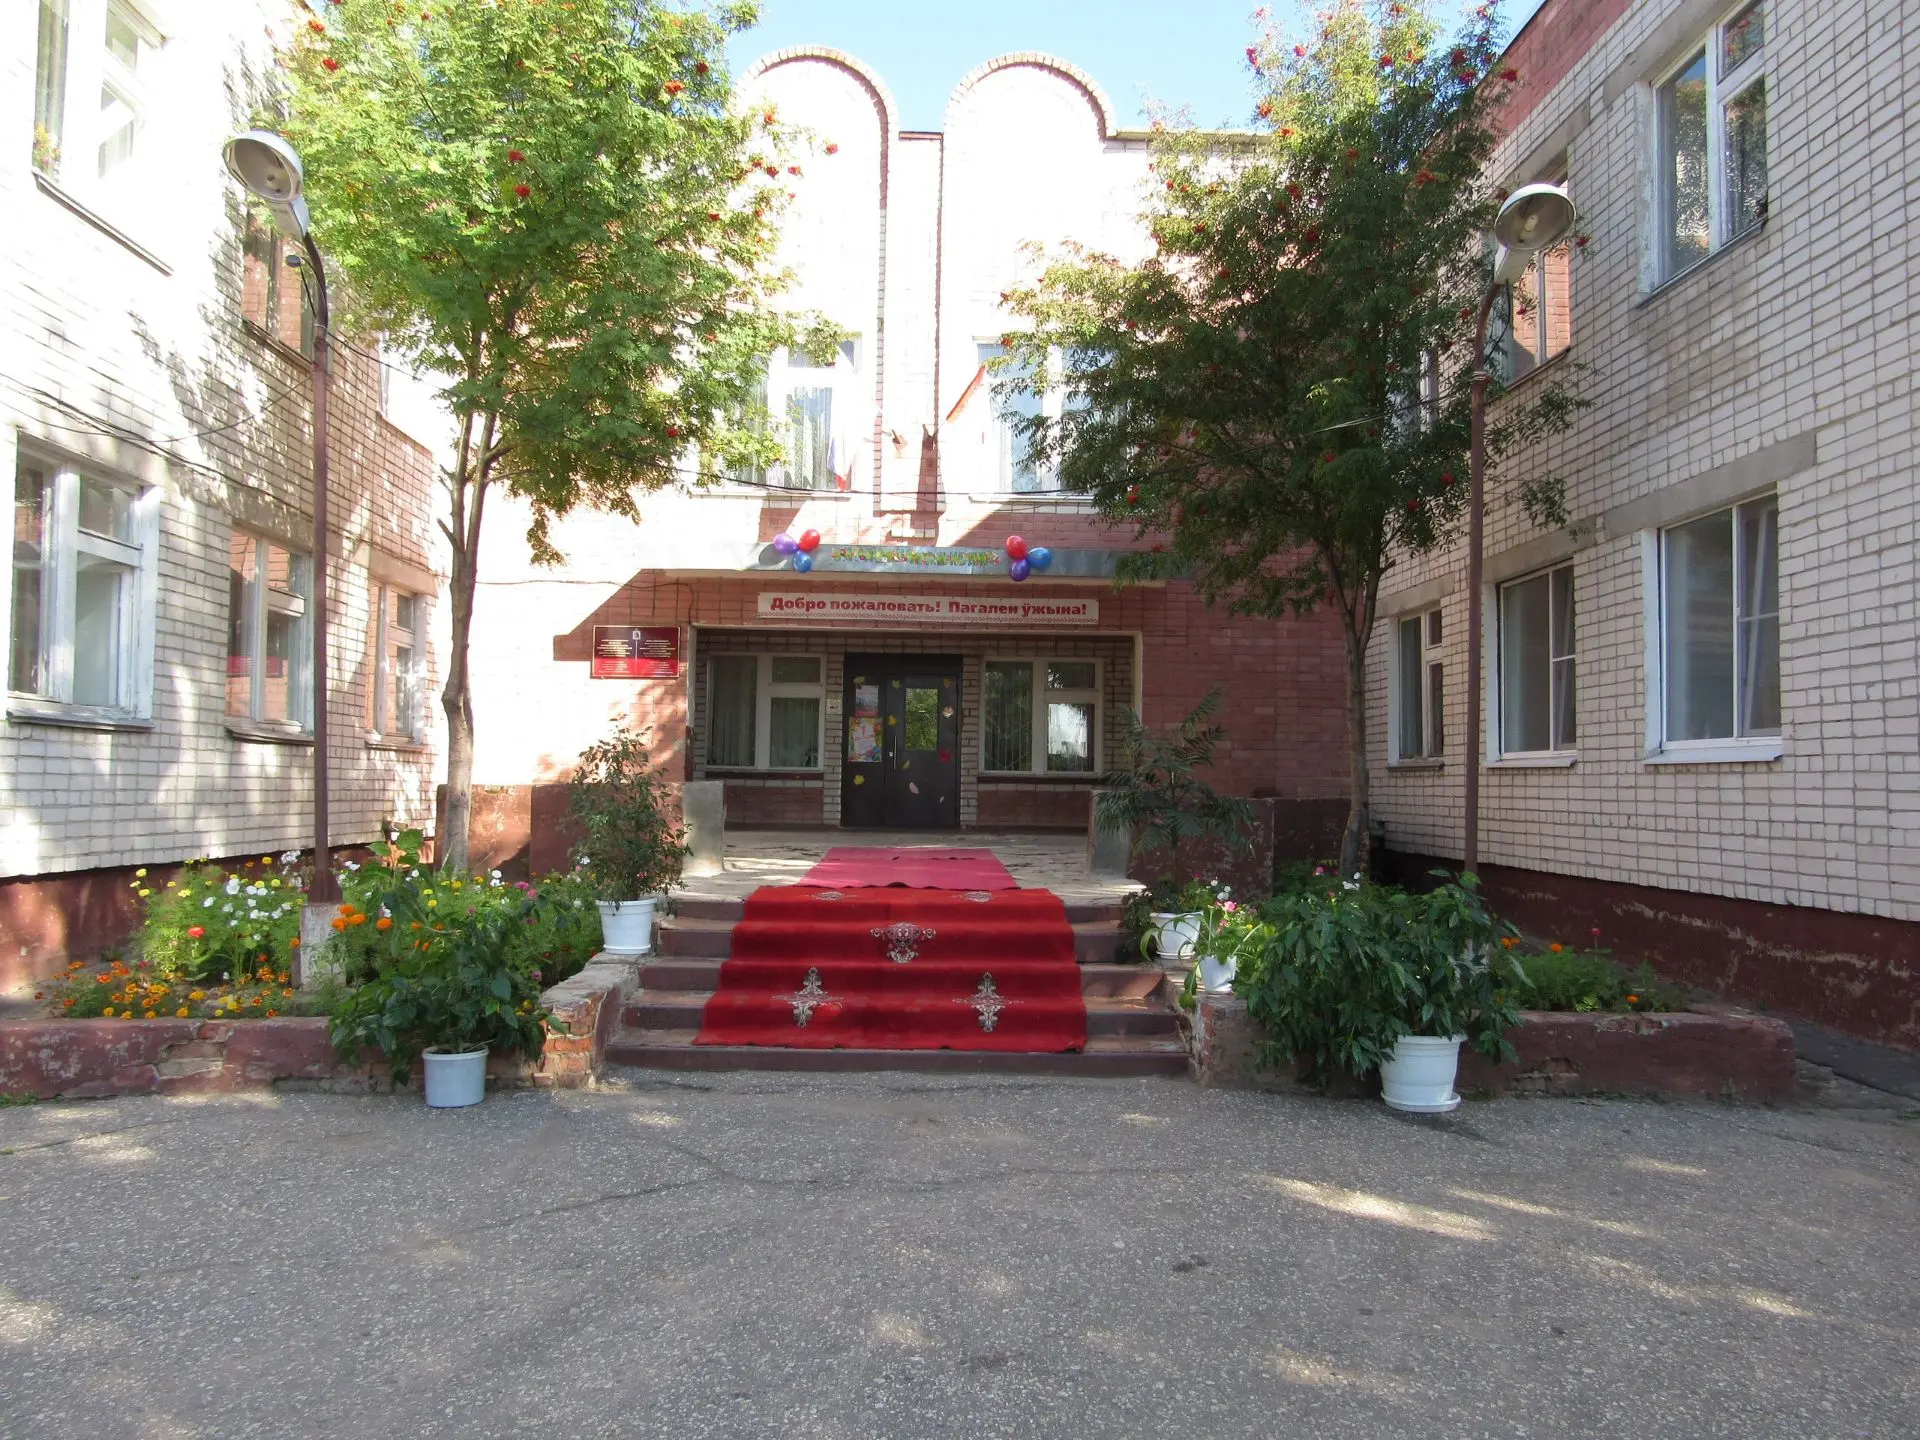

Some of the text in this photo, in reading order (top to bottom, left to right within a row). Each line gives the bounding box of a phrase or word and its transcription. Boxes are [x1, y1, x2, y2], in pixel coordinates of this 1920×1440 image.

[770, 596, 826, 612] Добро
[831, 599, 940, 612] пожаловать!
[948, 601, 1019, 614] Пагален
